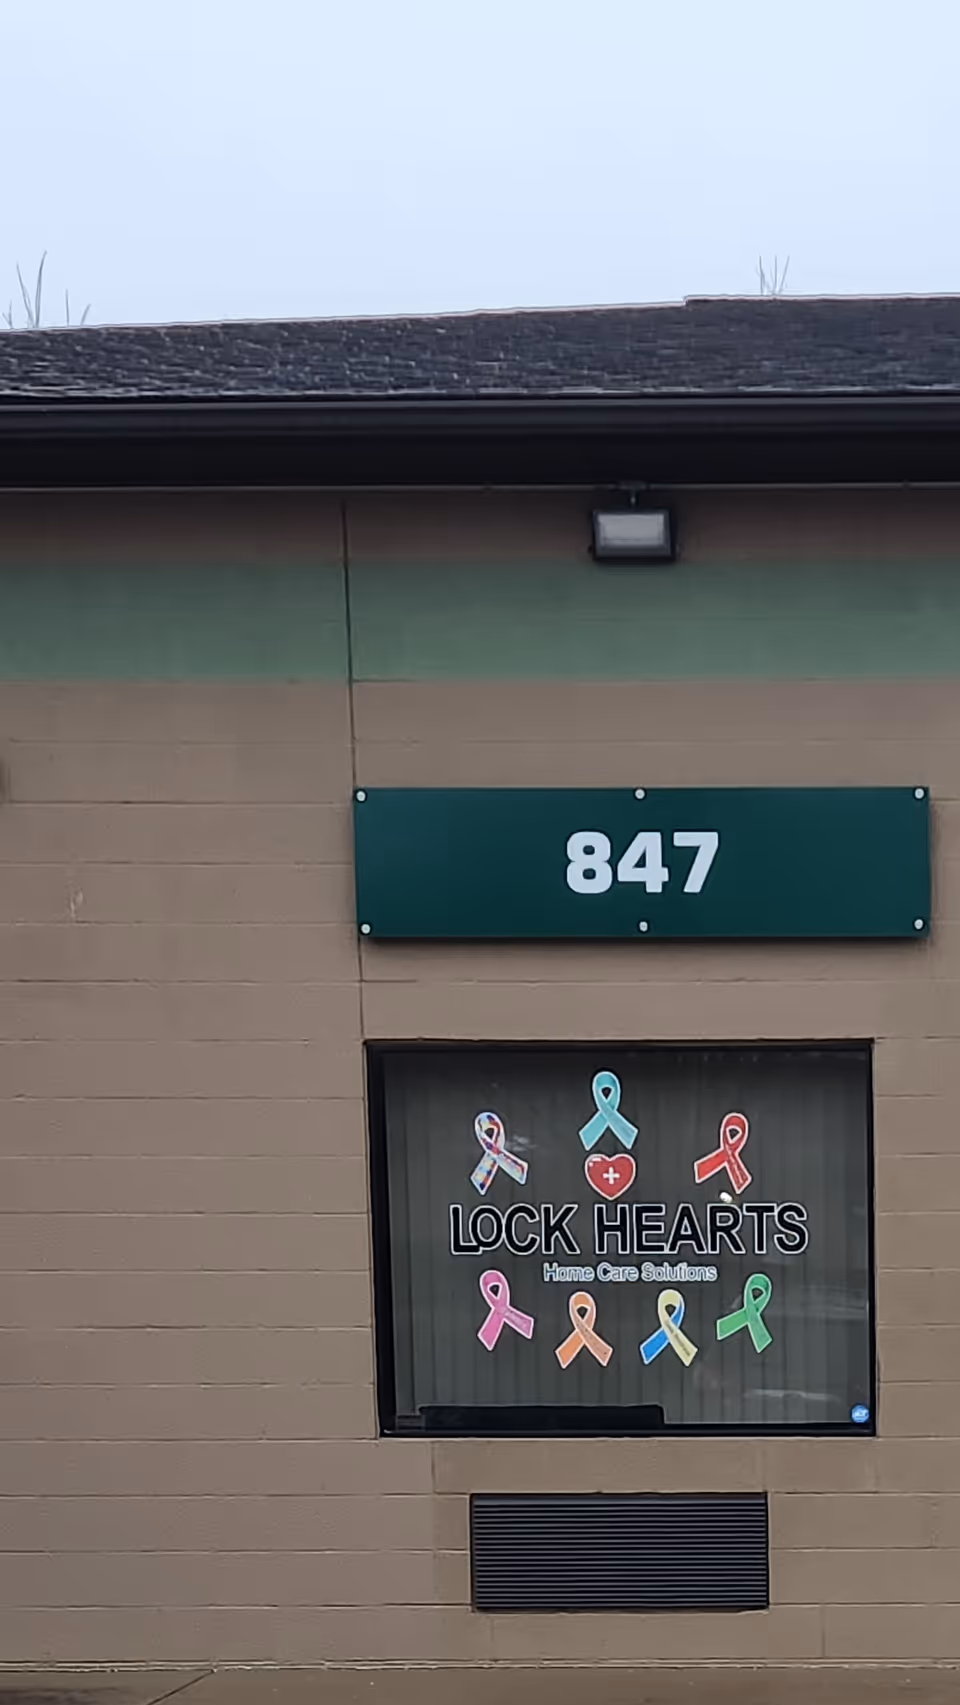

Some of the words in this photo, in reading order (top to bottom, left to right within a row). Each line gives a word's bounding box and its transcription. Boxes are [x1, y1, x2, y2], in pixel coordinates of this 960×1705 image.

[566, 831, 719, 894] 847
[449, 1203, 581, 1256] LOCK
[594, 1203, 808, 1255] HEARTS
[543, 1262, 595, 1282] Home
[598, 1262, 639, 1282] Care
[641, 1261, 718, 1282] Solutions
